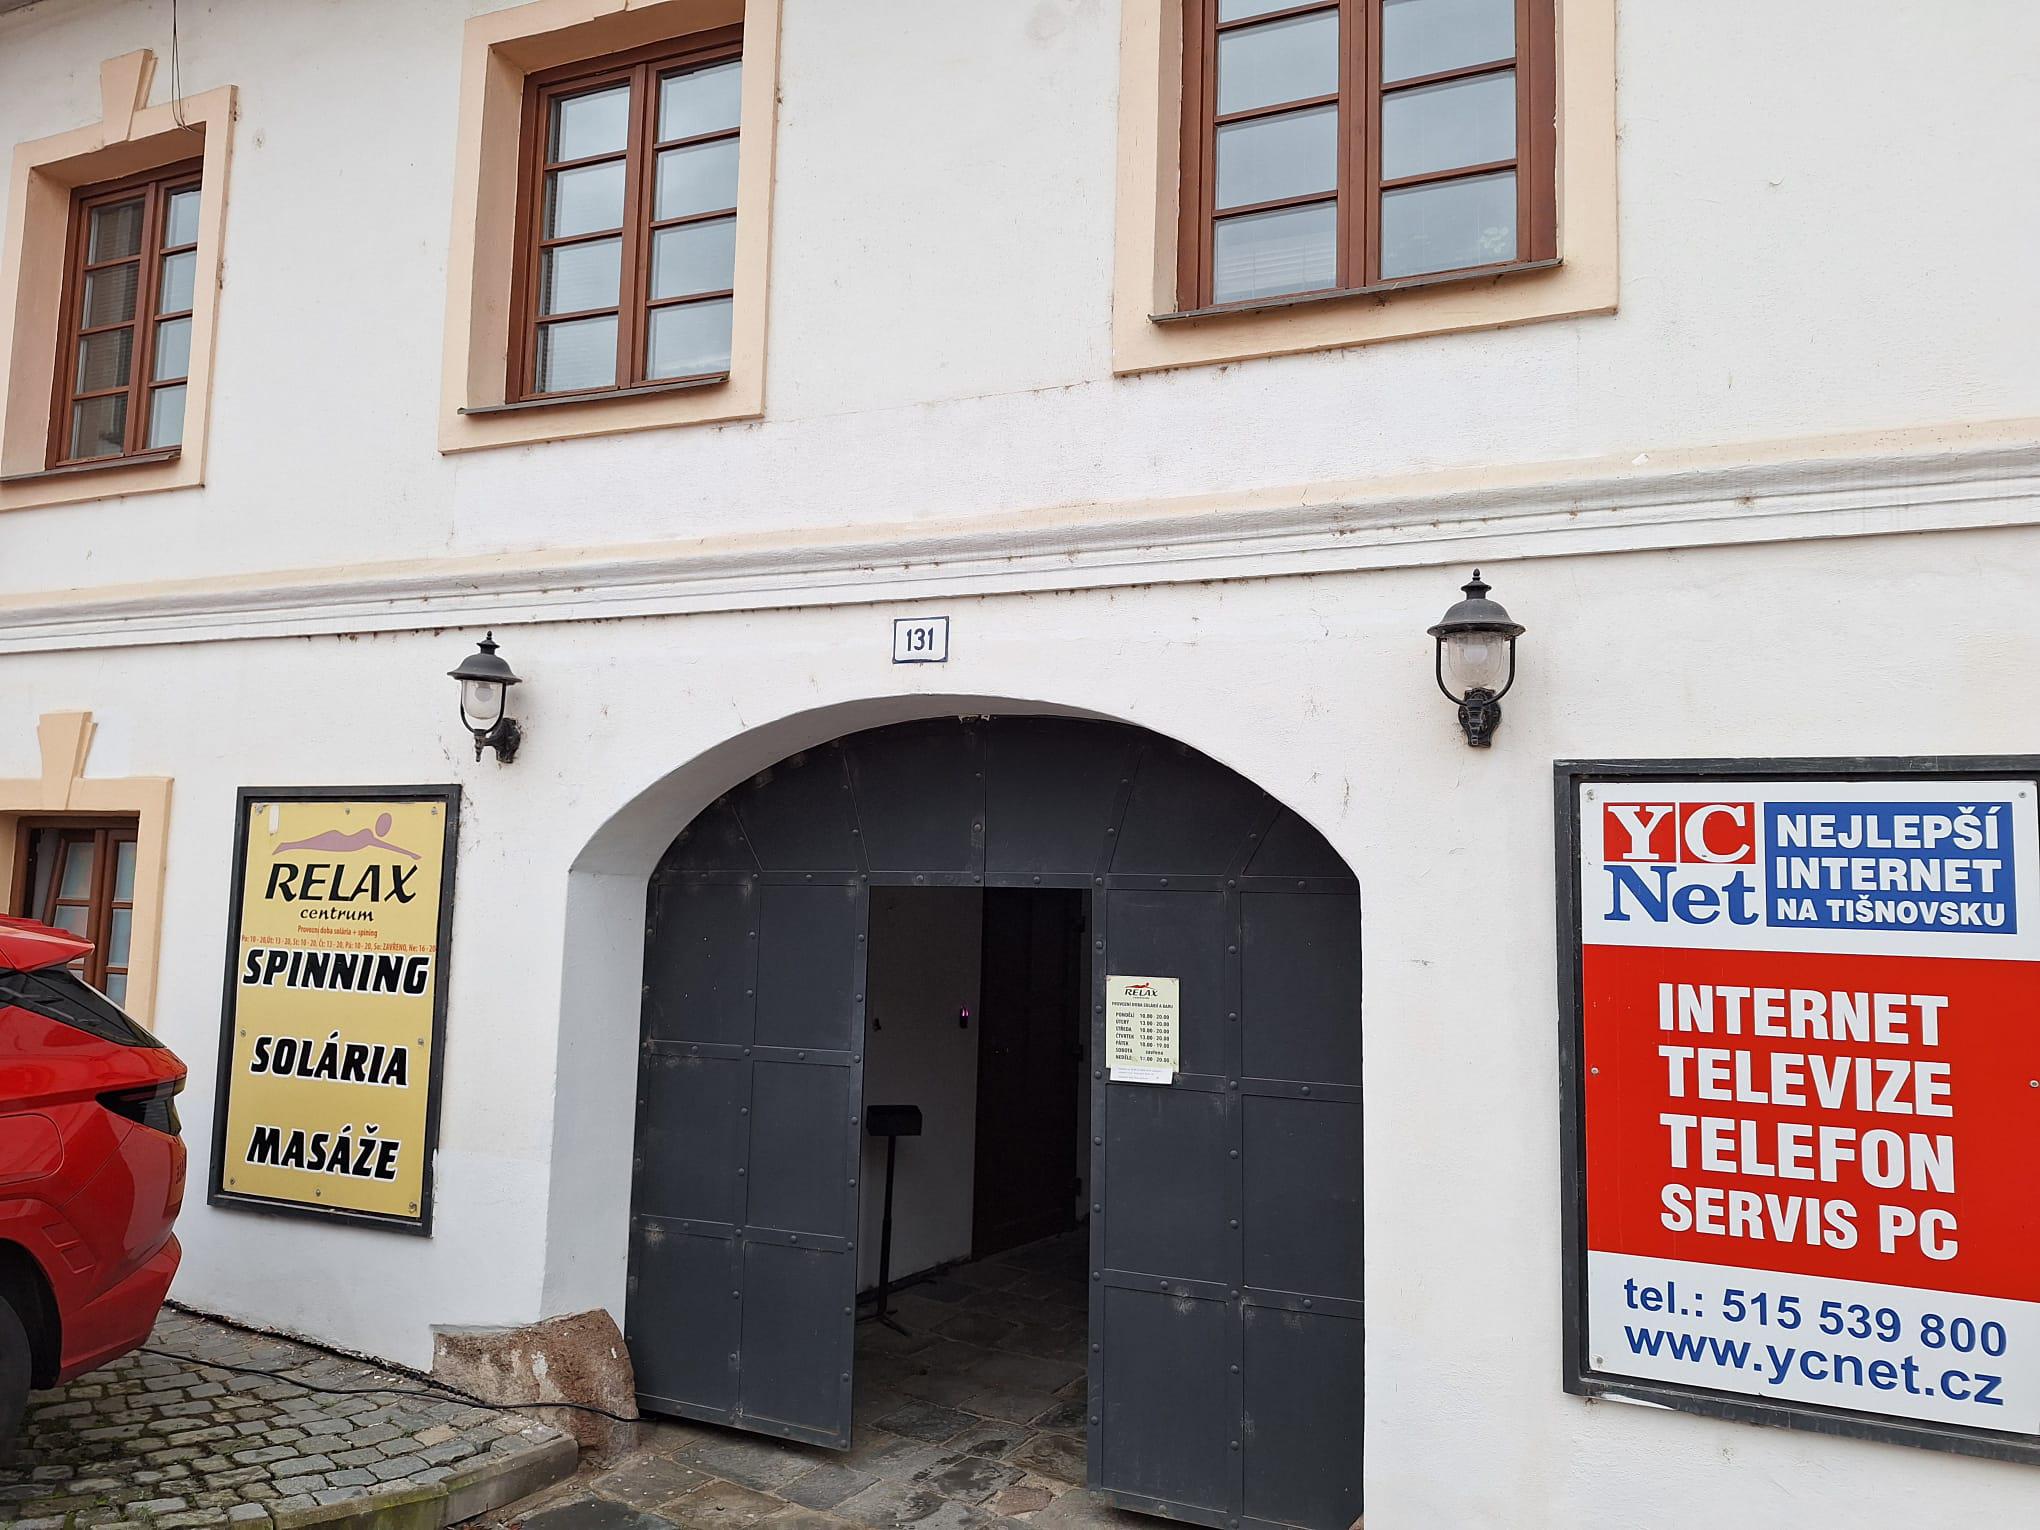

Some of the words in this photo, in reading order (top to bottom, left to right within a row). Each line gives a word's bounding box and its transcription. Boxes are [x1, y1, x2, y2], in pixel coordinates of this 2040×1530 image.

[907, 627, 934, 651] 131
[1607, 804, 1751, 863] YC
[1777, 806, 2002, 850] NEJLEPŠÍ
[264, 863, 418, 904] RELAX
[1604, 866, 1759, 925] Net
[1776, 857, 2002, 893] INTERNET
[300, 907, 374, 922] centrum
[320, 926, 333, 934] doba
[358, 928, 378, 938] spining
[1777, 899, 1818, 921] NA
[1826, 895, 2005, 926] TIŠNOVSKU
[243, 949, 430, 994] SPINNING
[1125, 988, 1158, 997] RELAX
[1658, 983, 1949, 1046] INTERNET
[251, 1031, 408, 1086] SOLÁRIA
[1659, 1045, 1953, 1118] TELEVIZE
[246, 1125, 400, 1180] MASÁŽE
[1660, 1113, 1956, 1193] TELEFON
[1661, 1183, 1858, 1249] SERVIS
[1879, 1204, 1958, 1260] PC
[1623, 1277, 1703, 1317] tel.:
[1722, 1289, 1802, 1330] 515
[1820, 1300, 1901, 1343] 539
[1920, 1313, 2007, 1357] 800
[1624, 1325, 2005, 1406] www.ycnet.cz
